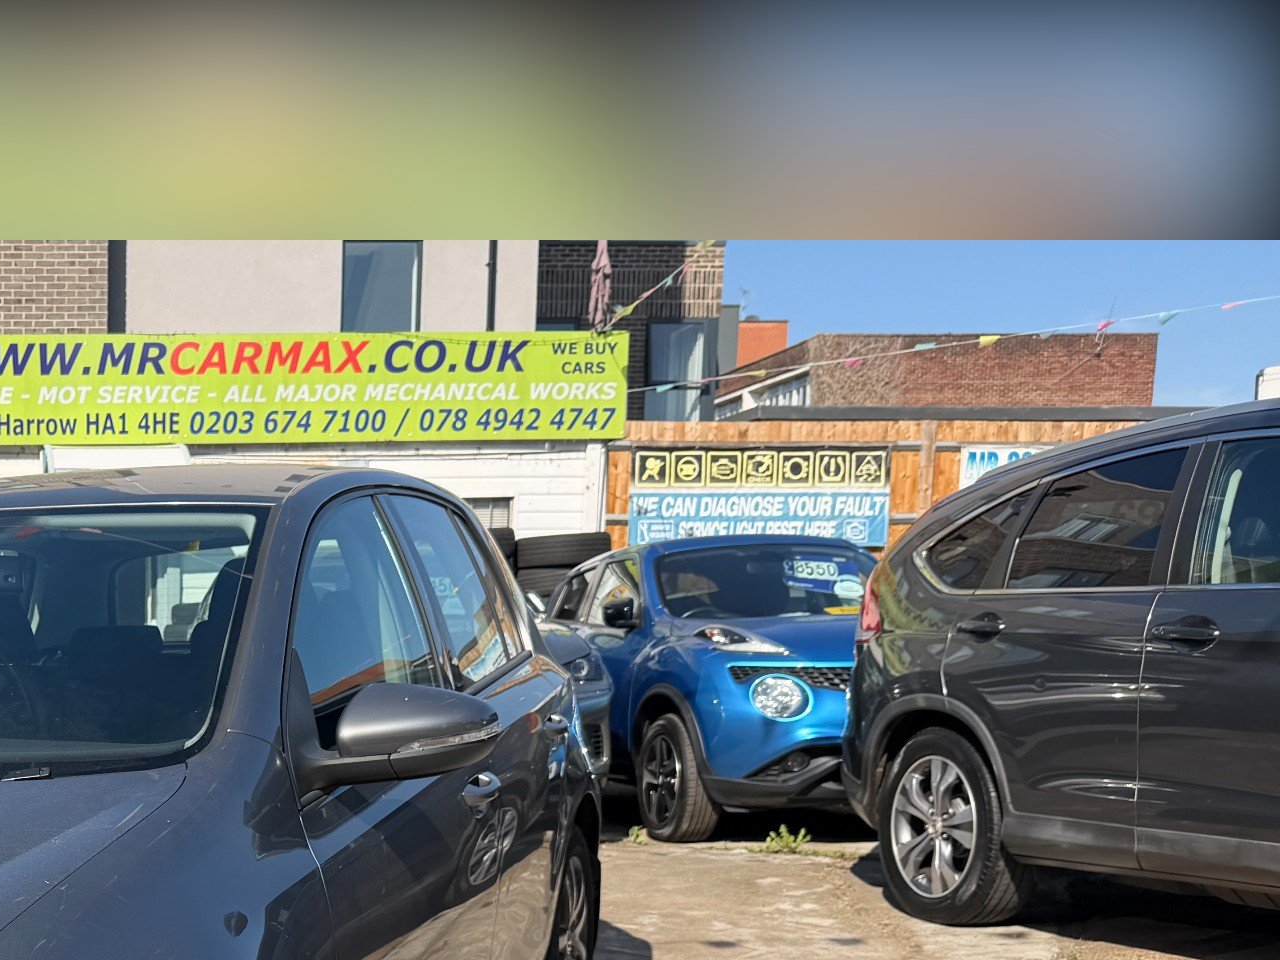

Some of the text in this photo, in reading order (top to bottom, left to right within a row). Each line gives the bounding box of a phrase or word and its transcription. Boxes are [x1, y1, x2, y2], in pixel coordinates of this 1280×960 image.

[552, 342, 618, 355] WE BUY
[561, 361, 606, 374] CARS
[38, 385, 92, 405] MOT
[97, 385, 201, 405] SERVICE
[223, 384, 268, 404] ALL
[275, 383, 358, 403] MAJOR
[364, 382, 521, 402] MECHANICAL
[529, 381, 618, 401] WORKS
[86, 412, 129, 436] HA1
[138, 411, 180, 435] 4HE
[189, 410, 255, 435] 0203
[263, 410, 312, 434] 674
[322, 409, 387, 433] 7100
[394, 408, 410, 437] /
[419, 408, 468, 433] 078
[476, 407, 541, 432] 4942
[549, 407, 617, 431] 4747
[632, 495, 886, 517] WE CAN DIAGNOSE YOUR FAULT
